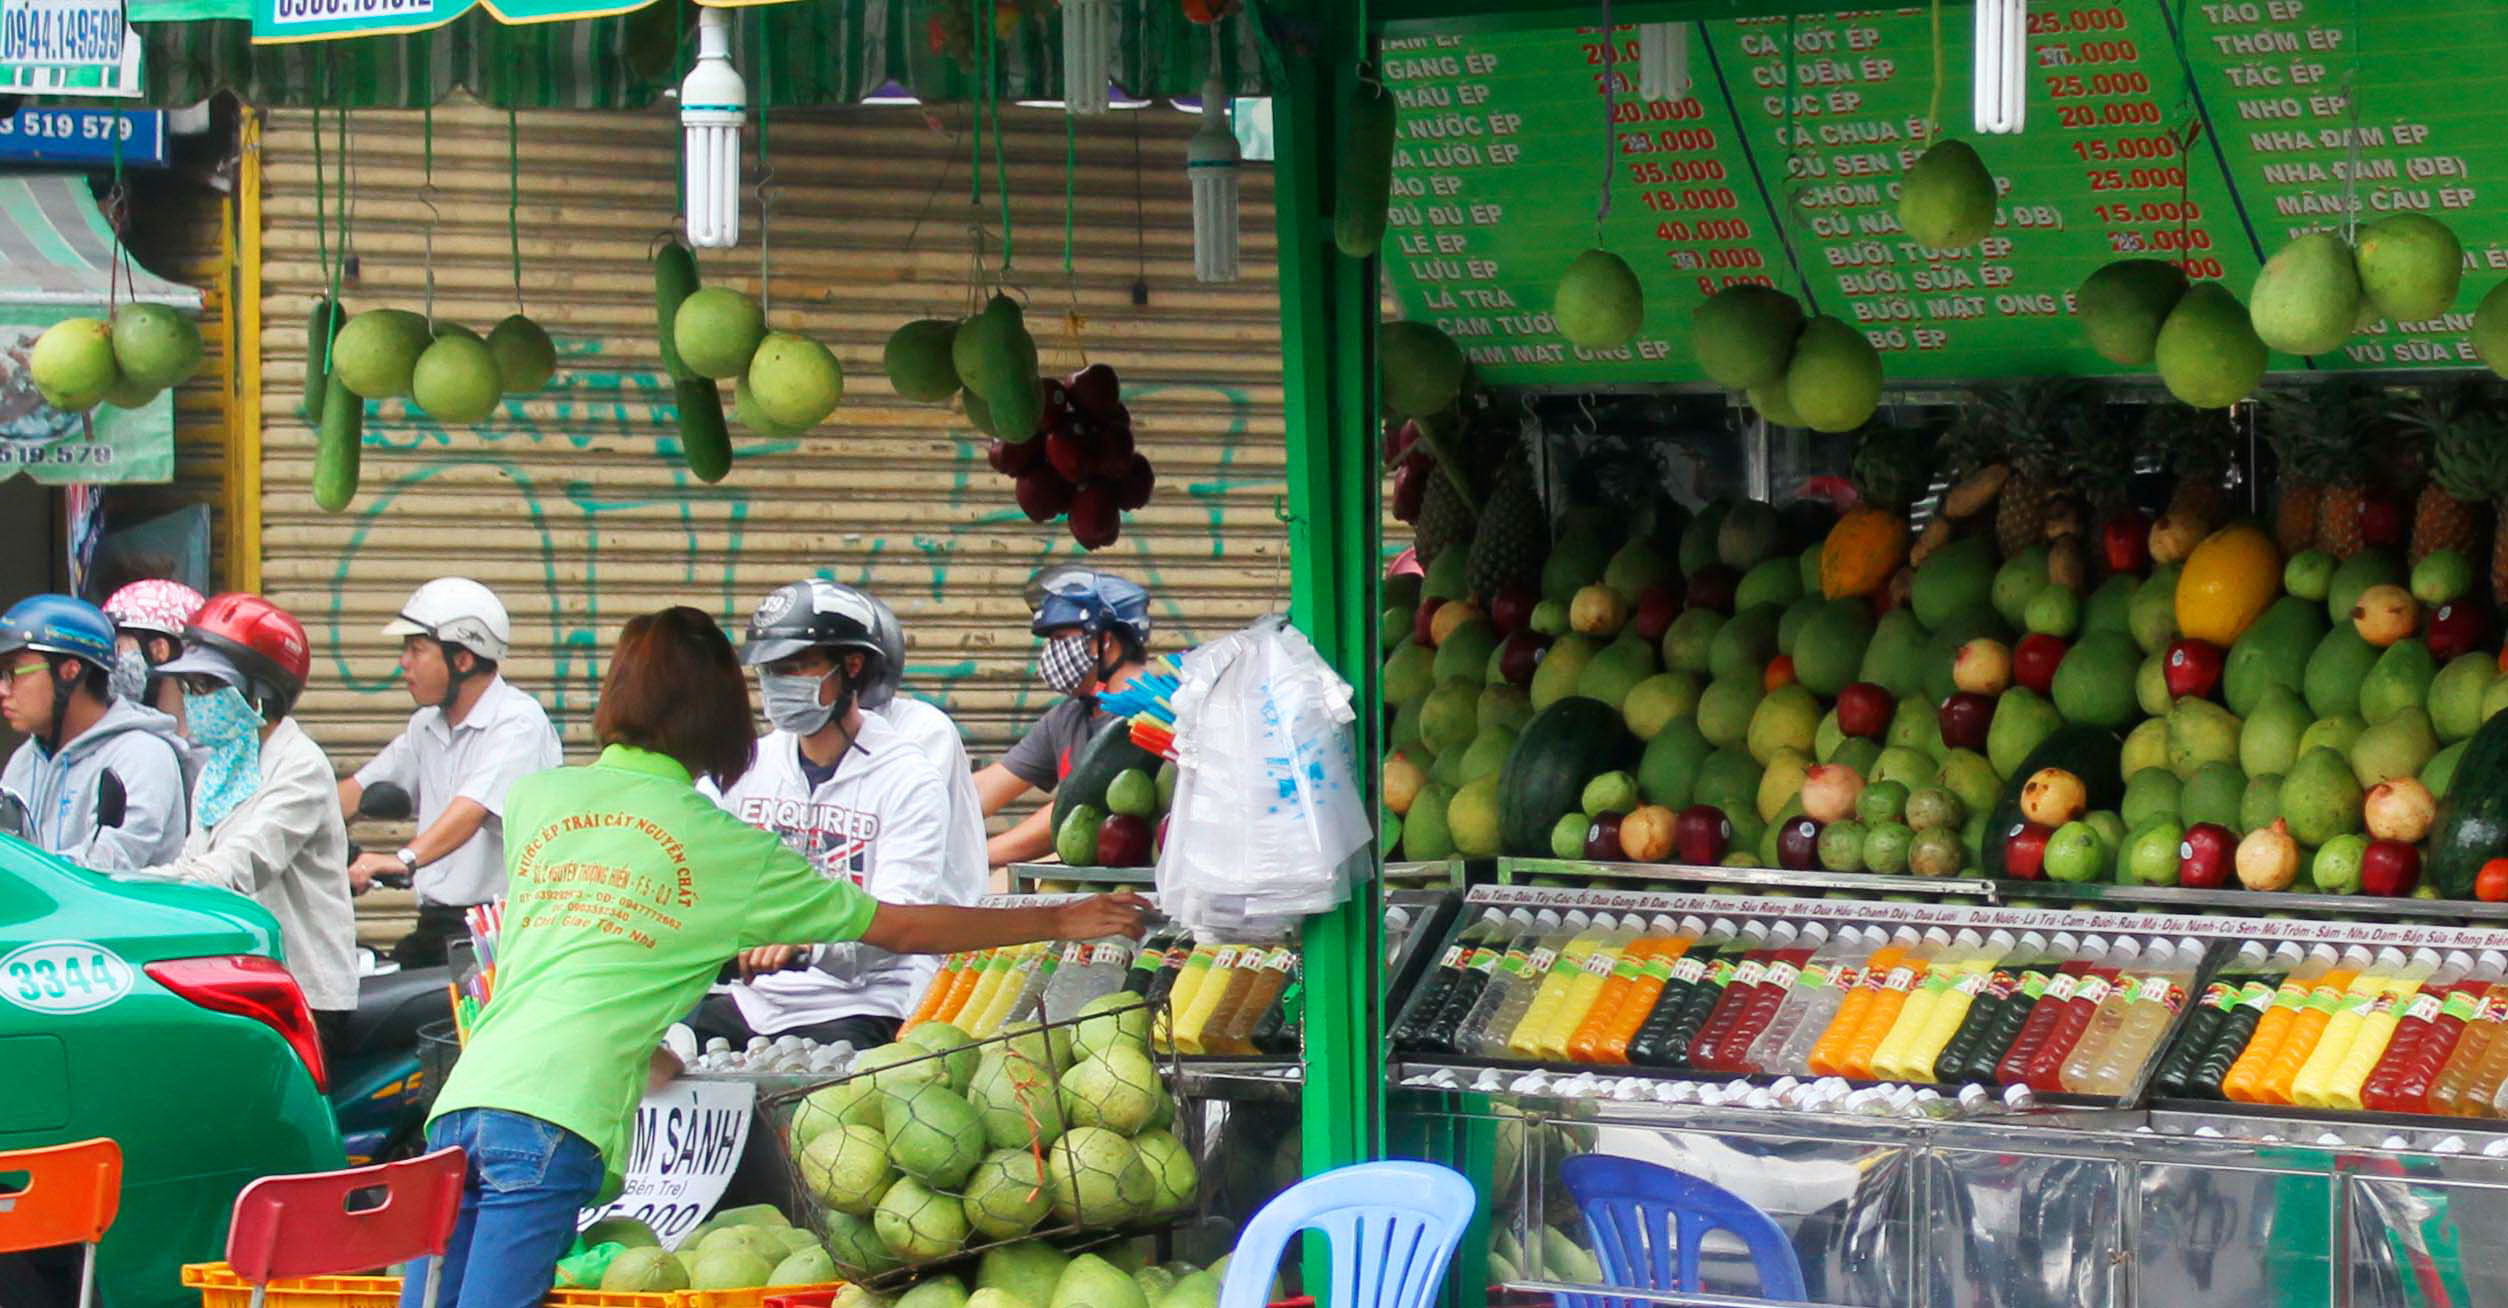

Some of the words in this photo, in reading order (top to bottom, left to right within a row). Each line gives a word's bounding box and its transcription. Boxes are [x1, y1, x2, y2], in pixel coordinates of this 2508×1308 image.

[4, 9, 121, 58] 0944.149599
[1845, 24, 1881, 52] ÉP
[2027, 8, 2128, 34] 25.000
[2305, 24, 2344, 51] ÉP
[1385, 57, 1460, 80] GANG
[1859, 55, 1896, 82] ÉP
[2287, 57, 2327, 86] ÉP
[1826, 86, 1863, 114] ÉP
[2047, 72, 2151, 100] 25.000
[2237, 97, 2302, 121] NHO
[2308, 90, 2347, 118] ÉP
[24, 112, 74, 139] 519
[82, 114, 133, 141] 579
[1820, 120, 1901, 147] CHUA
[2057, 101, 2162, 128] 20.000
[2250, 129, 2315, 152] NHA
[2391, 118, 2429, 147] ÉP
[1833, 153, 1892, 178] SEN
[2071, 135, 2176, 162] 15.000
[1629, 160, 1727, 184] 35.000
[2087, 166, 2187, 191] 25.000
[2263, 162, 2327, 184] NHA
[1641, 188, 1738, 212] 18.000
[2438, 184, 2477, 210] ÉP
[2095, 201, 2201, 224] 15.000
[1656, 219, 1752, 241] 40.000
[1978, 261, 2015, 288] ÉP
[1995, 292, 2057, 316] ONG
[1436, 317, 1494, 337] CAM
[1913, 323, 1949, 350] ÉP
[1636, 336, 1671, 361] ÉP
[9, 954, 119, 1000] 3344
[661, 1090, 742, 1175] SÀNH
[658, 1179, 688, 1199] Tre)
